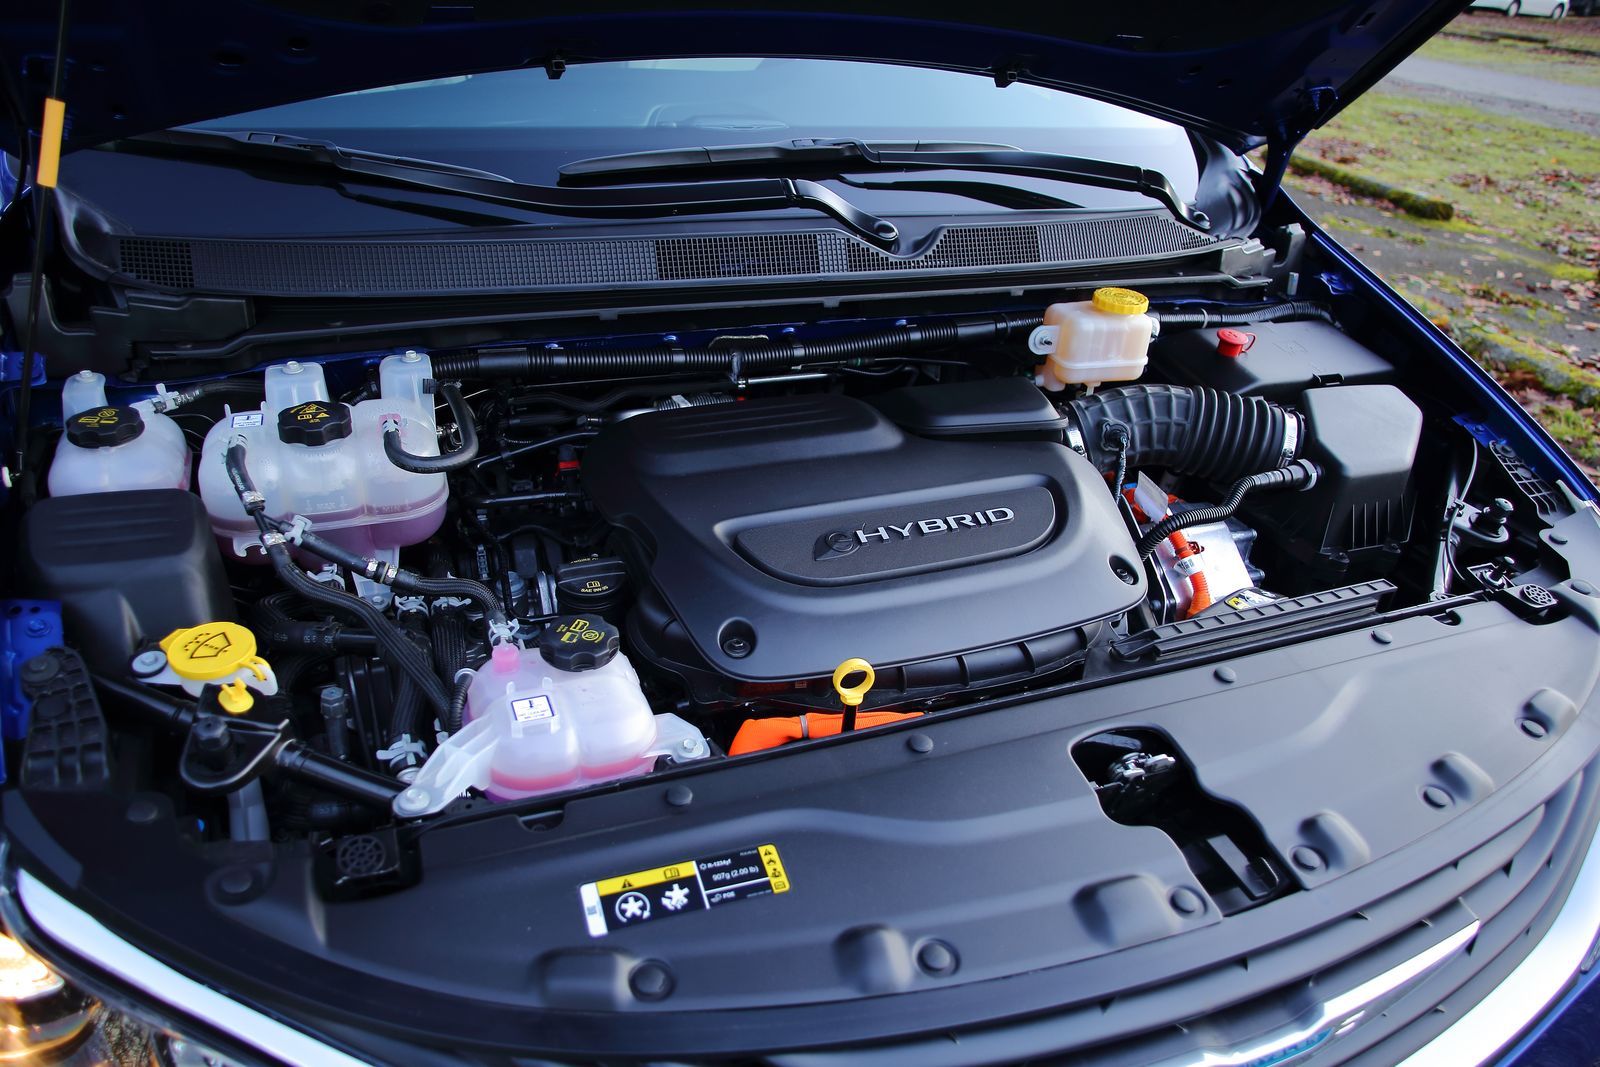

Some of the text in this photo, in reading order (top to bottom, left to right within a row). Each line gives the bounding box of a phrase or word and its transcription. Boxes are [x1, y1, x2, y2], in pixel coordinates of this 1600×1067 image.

[855, 507, 1015, 544] HYBRID
[712, 865, 759, 881] 907g (2.00 lb)
